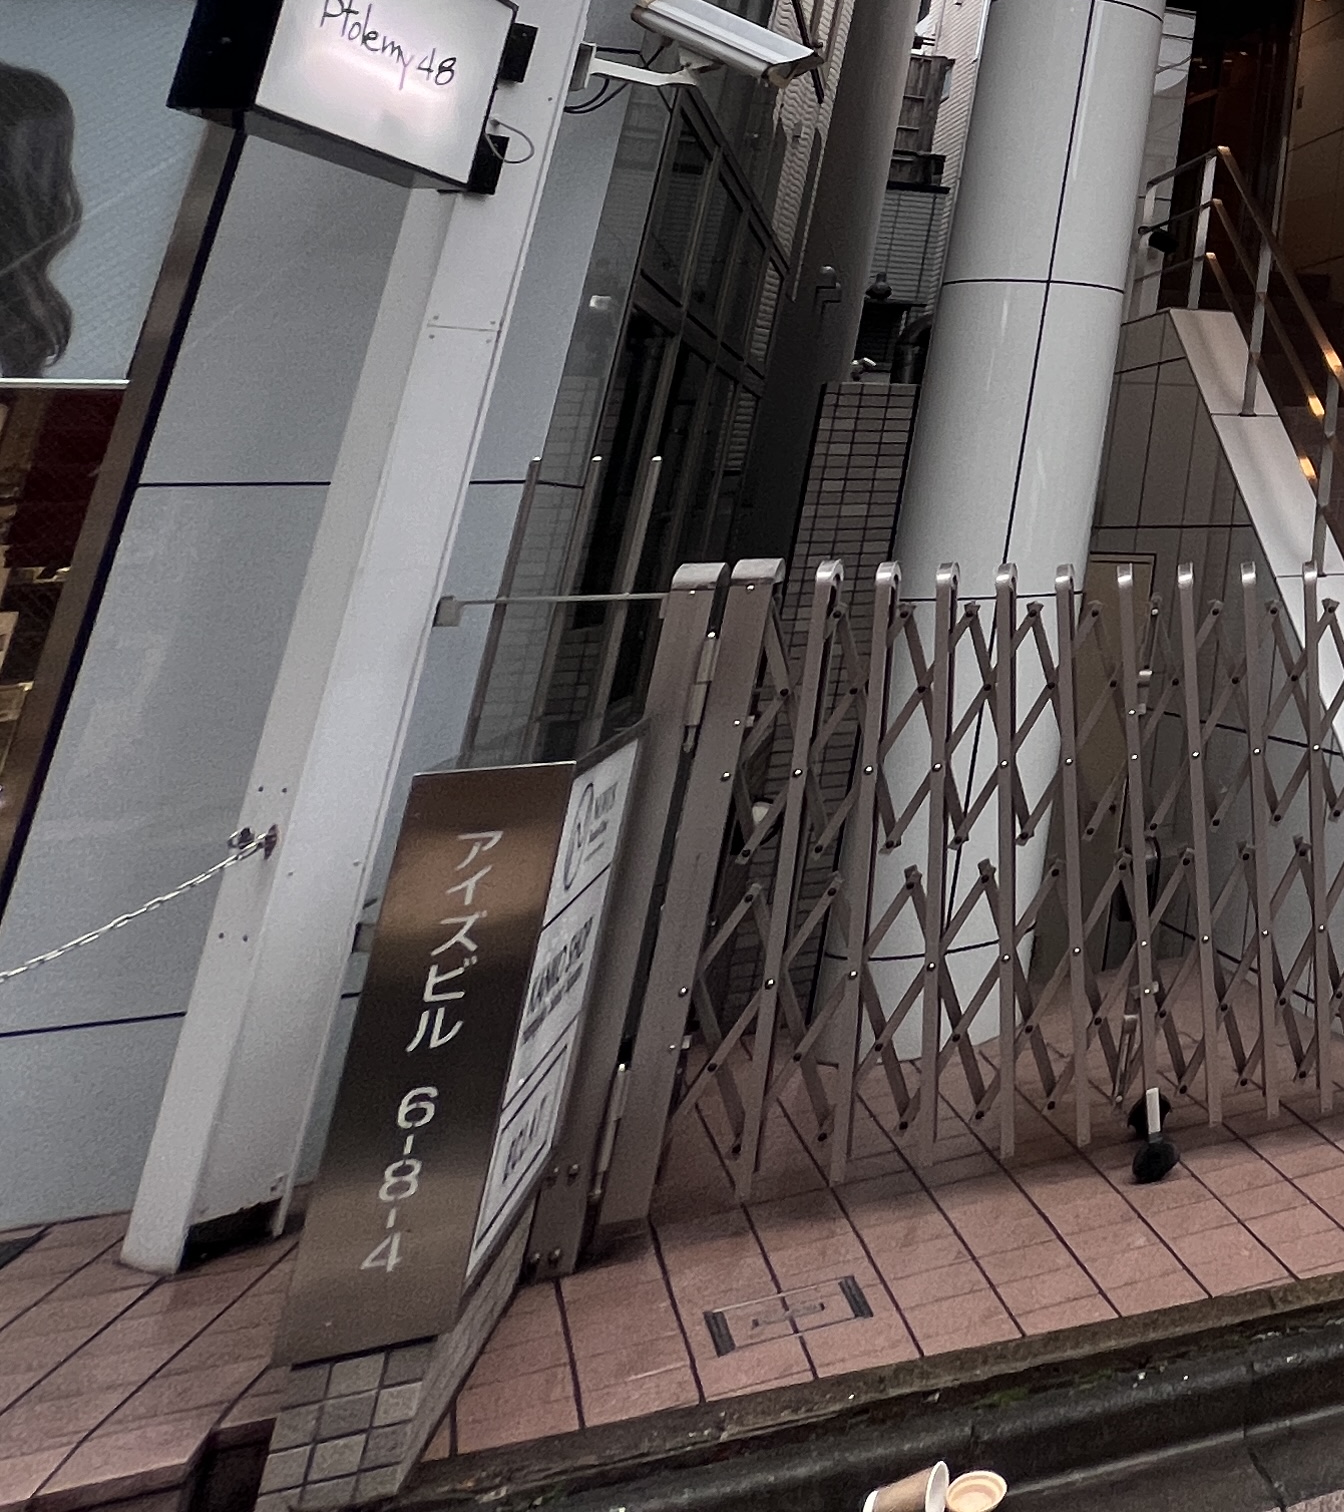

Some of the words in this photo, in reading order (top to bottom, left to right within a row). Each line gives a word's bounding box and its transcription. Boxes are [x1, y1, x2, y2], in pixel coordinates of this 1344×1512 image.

[416, 48, 457, 85] 48
[406, 830, 503, 1052] アイズビル
